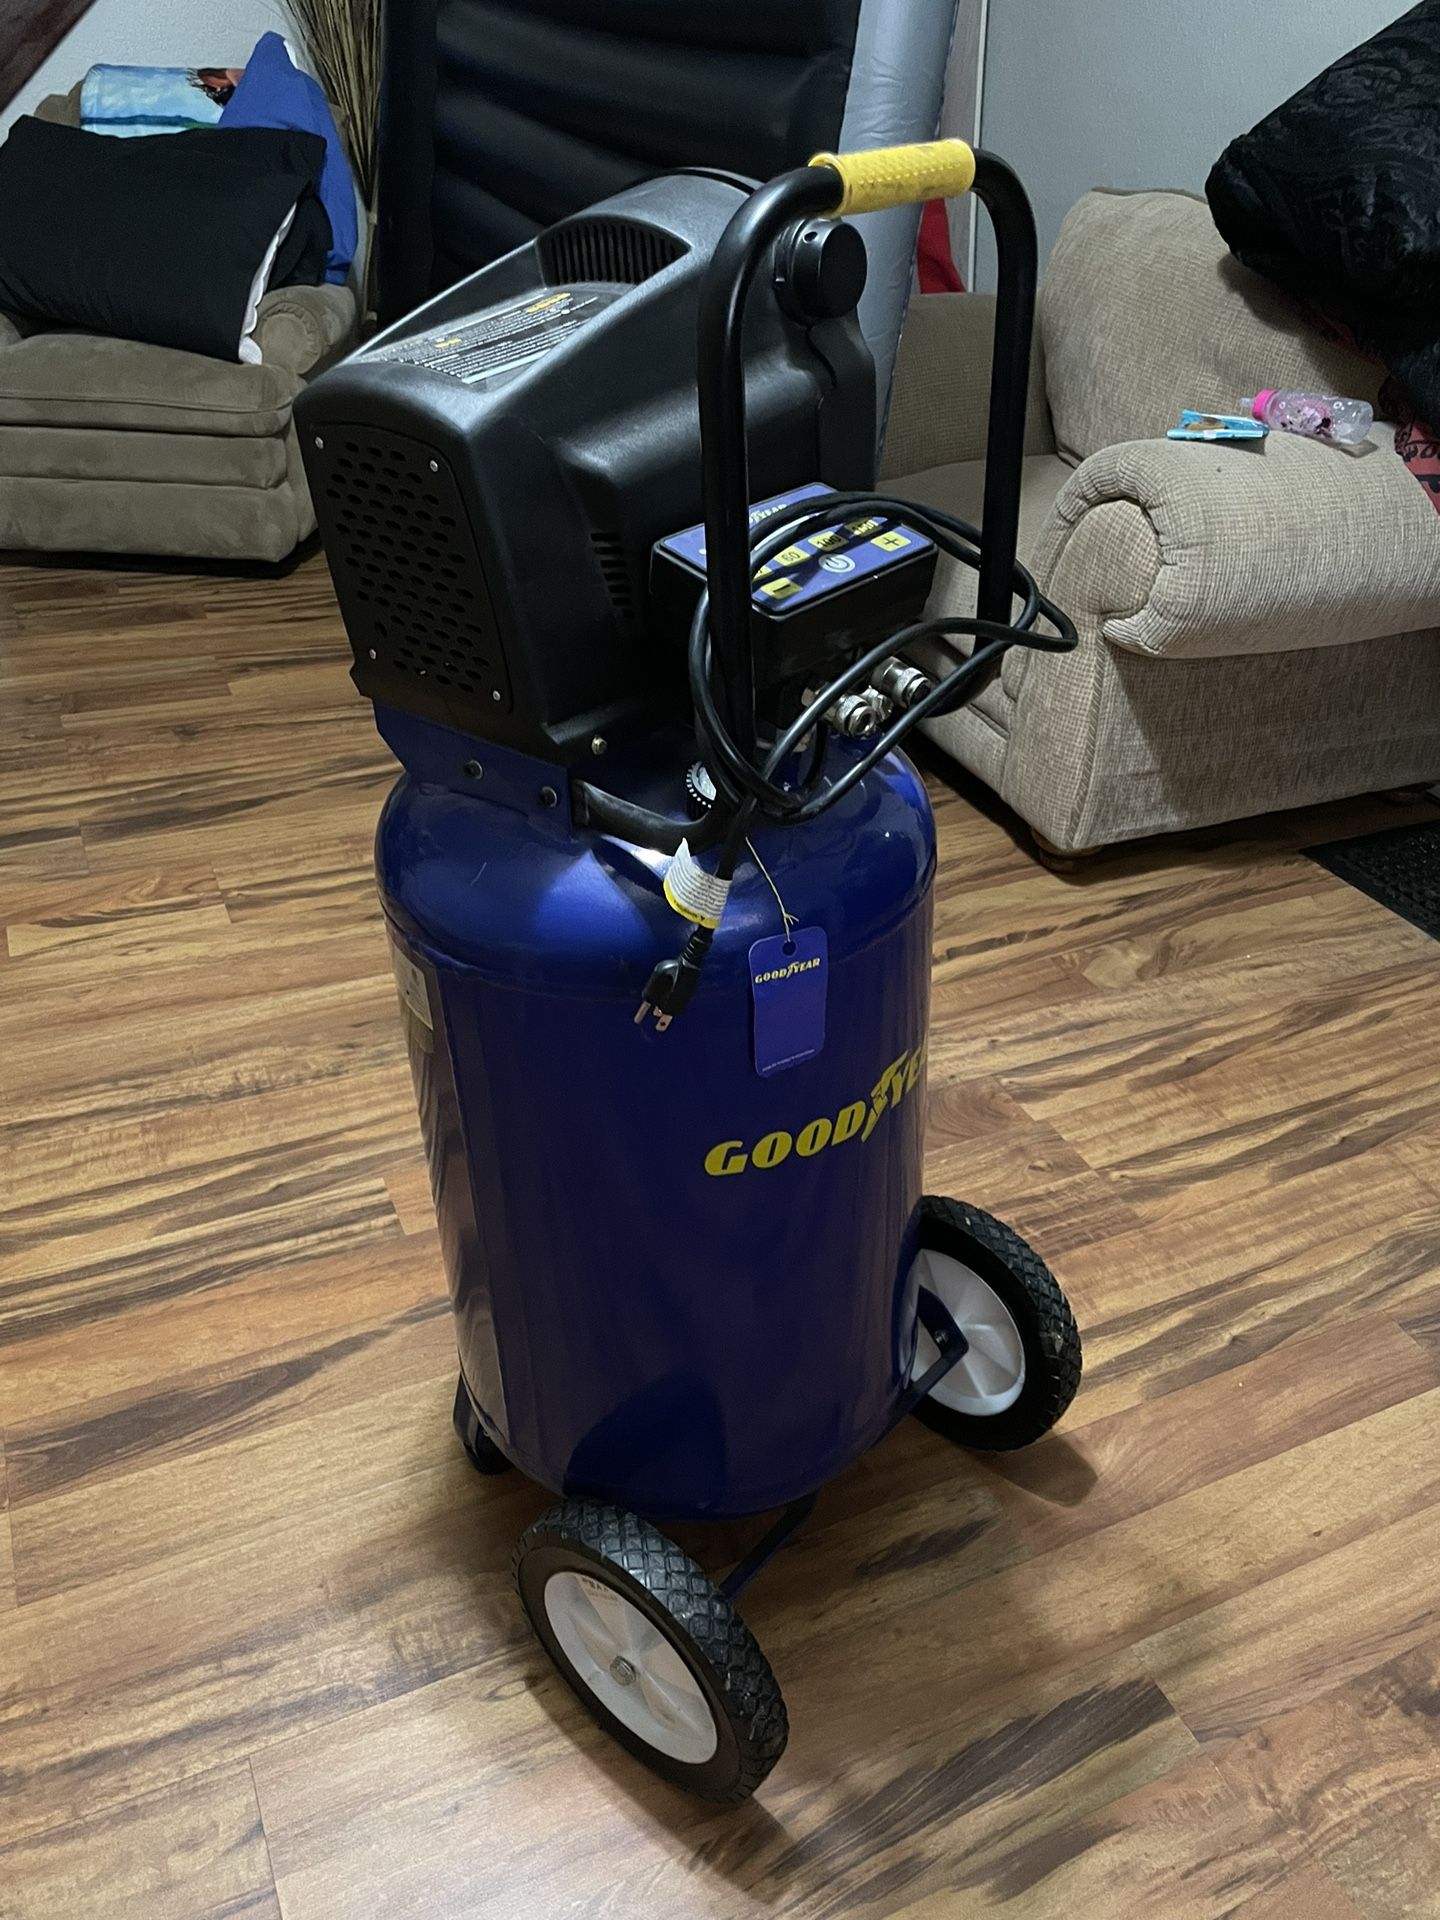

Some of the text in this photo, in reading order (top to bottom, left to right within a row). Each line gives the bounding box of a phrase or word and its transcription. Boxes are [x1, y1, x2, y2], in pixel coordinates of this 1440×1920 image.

[816, 535, 842, 548] 100
[754, 957, 821, 984] GOODYEAR
[704, 1043, 928, 1177] GOODYE
